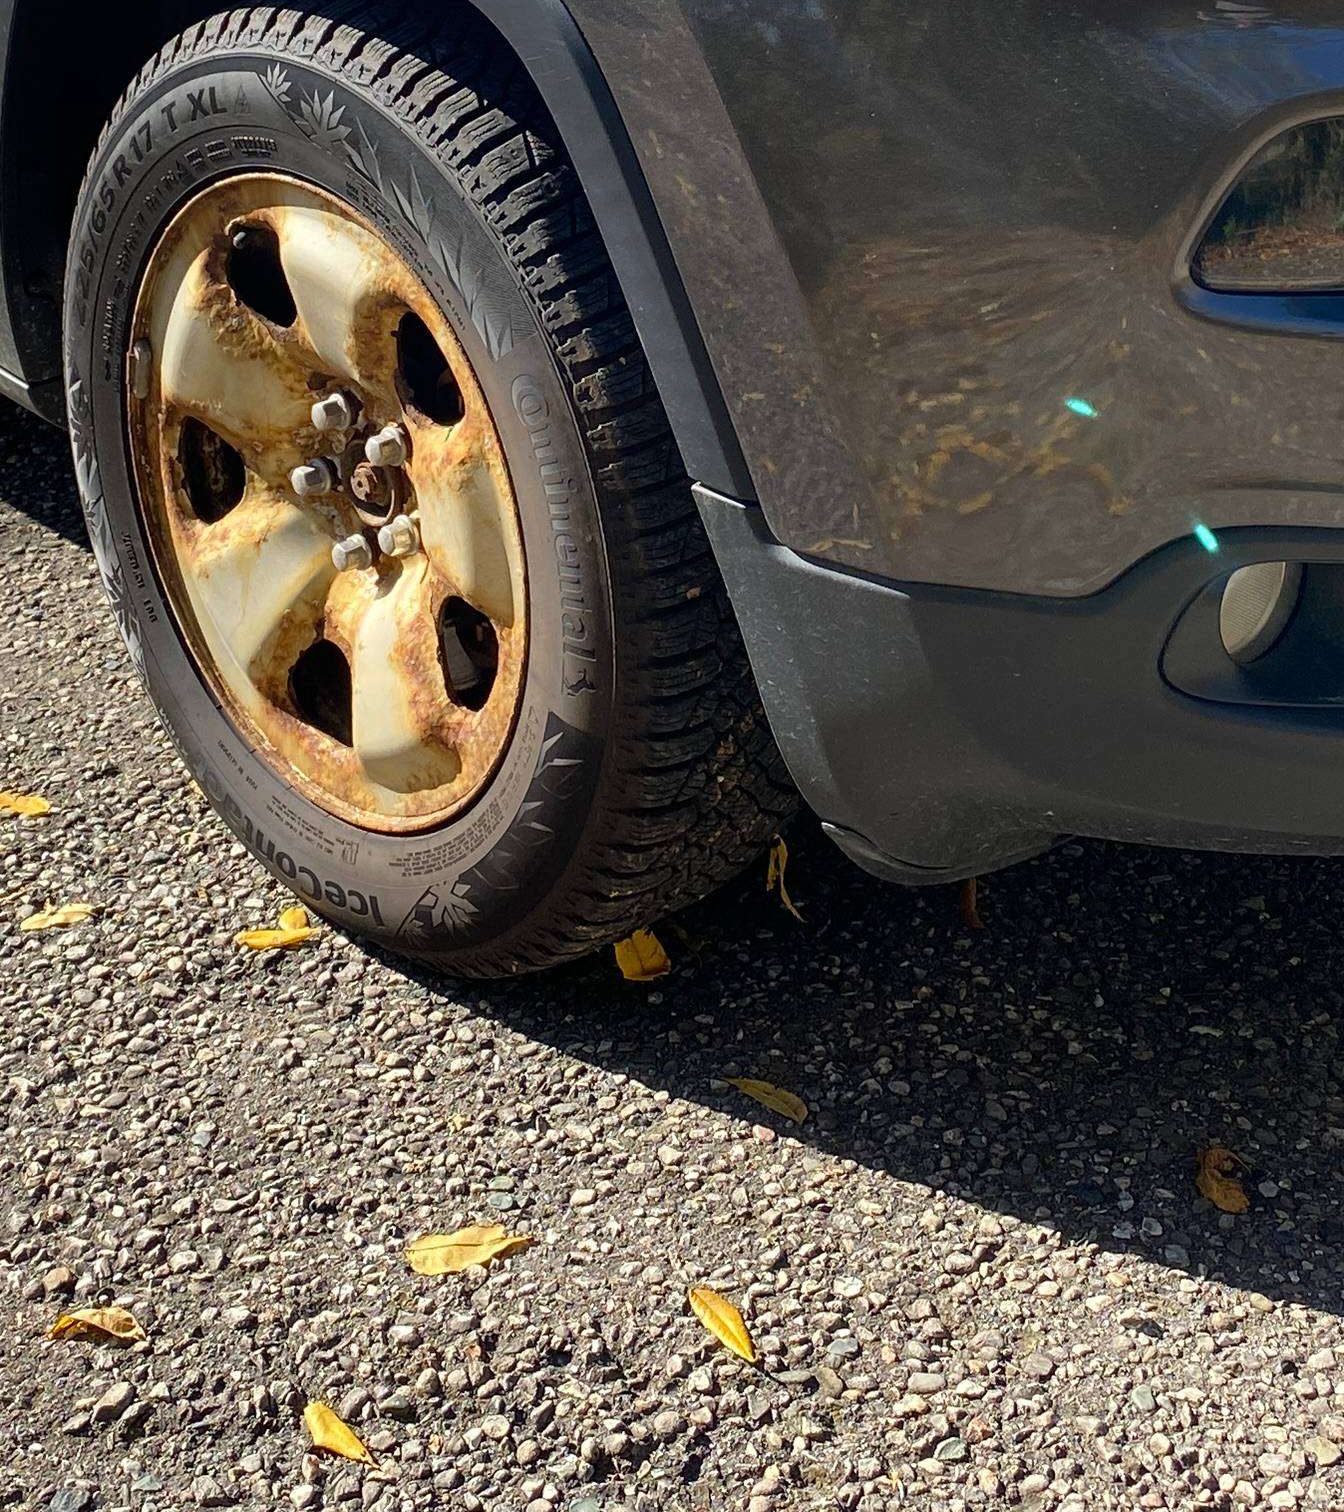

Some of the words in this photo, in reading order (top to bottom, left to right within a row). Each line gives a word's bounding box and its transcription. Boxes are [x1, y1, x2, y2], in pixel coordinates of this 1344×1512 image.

[112, 153, 133, 188] R
[129, 119, 154, 162] 17
[160, 100, 179, 133] T
[186, 86, 228, 122] XL
[511, 374, 597, 664] Continental
